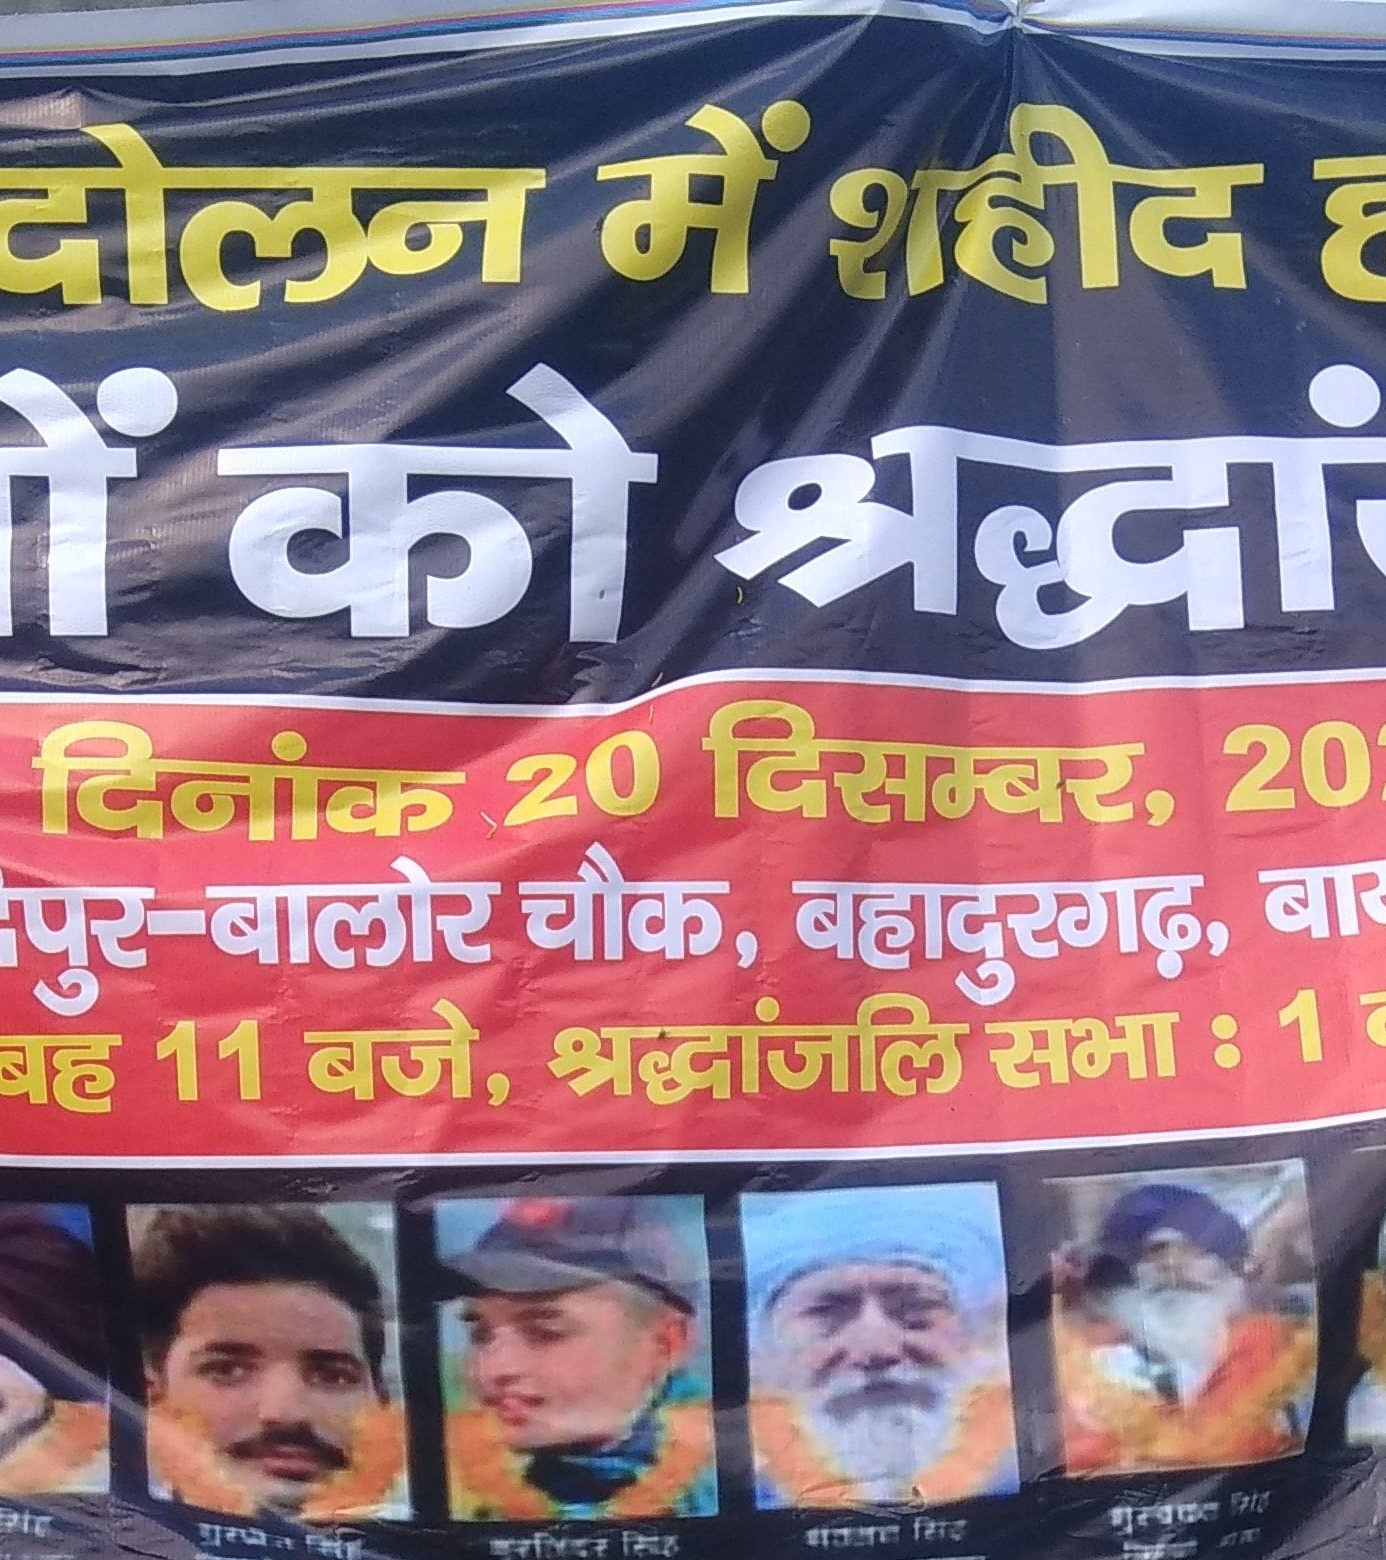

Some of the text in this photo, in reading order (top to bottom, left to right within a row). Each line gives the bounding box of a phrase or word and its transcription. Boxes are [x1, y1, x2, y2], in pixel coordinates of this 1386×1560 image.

[597, 98, 810, 294] में
[829, 104, 1263, 305] शहीद
[219, 361, 657, 644] को
[32, 720, 463, 842] दिनांक
[501, 729, 662, 827] 20
[702, 700, 1175, 828] दिसम्बर,
[518, 841, 760, 970] चौक,
[792, 871, 1229, 1006] बहादुरगढ़,
[156, 1018, 264, 1102] 11
[303, 999, 511, 1109] बजे,
[546, 991, 969, 1107] श्रद्धांजलि
[984, 1010, 1180, 1089] सभा
[1276, 988, 1324, 1065] 1
